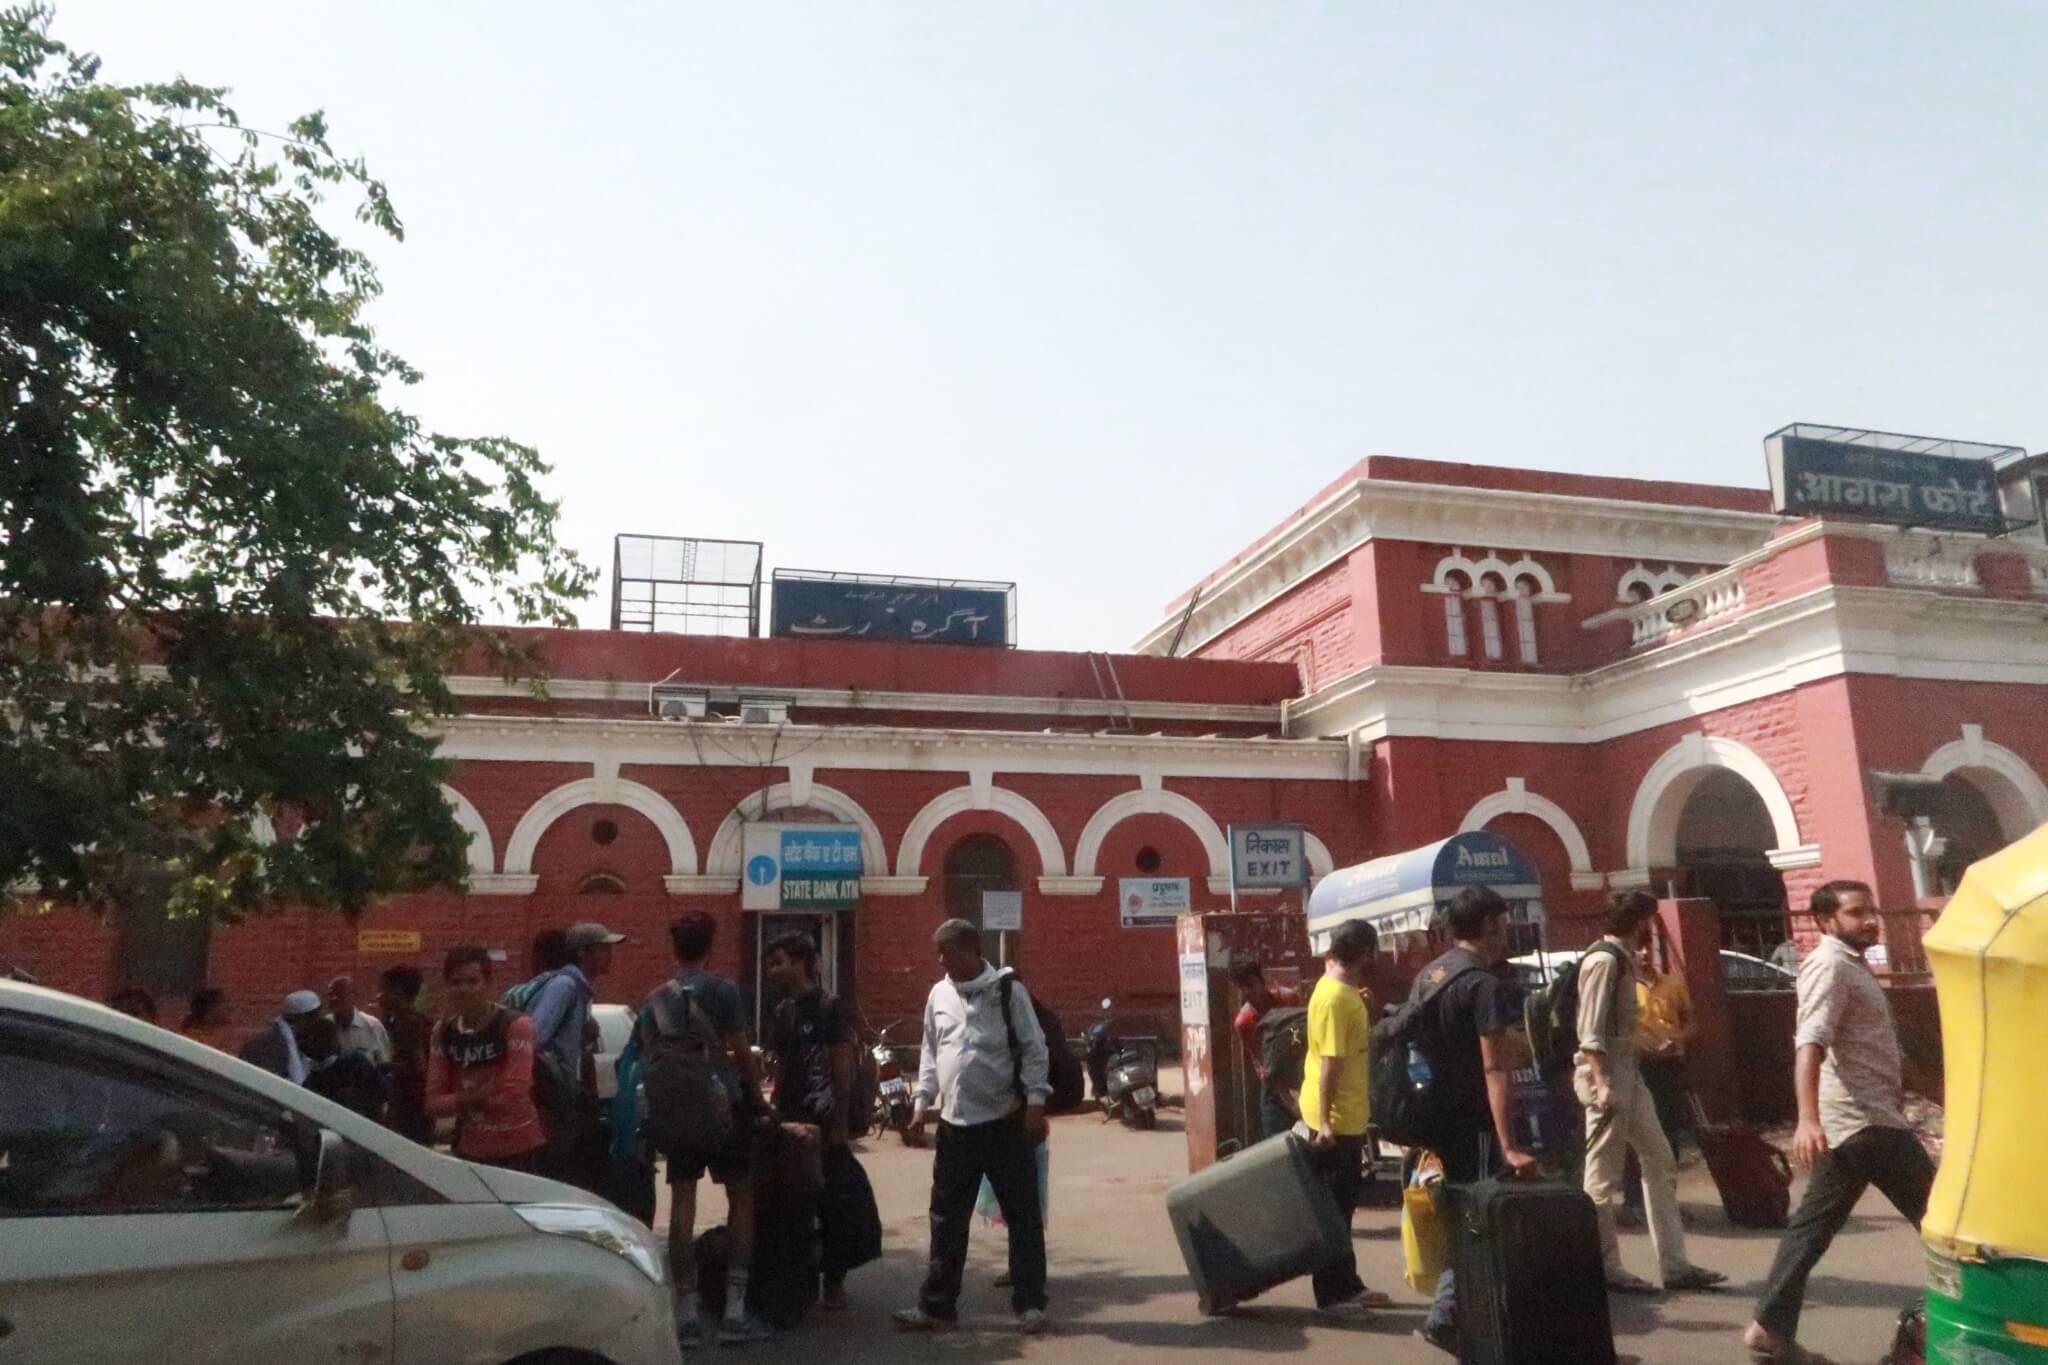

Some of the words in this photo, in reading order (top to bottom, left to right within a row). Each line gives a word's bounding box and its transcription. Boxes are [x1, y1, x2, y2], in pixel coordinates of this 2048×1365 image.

[1921, 477, 1993, 516] फोर्ट
[1245, 831, 1292, 855] निकास
[1456, 845, 1510, 867] Amul
[1247, 860, 1291, 877] EXIT
[783, 879, 812, 900] STATE
[813, 879, 839, 900] BANK
[840, 879, 860, 900] ATM
